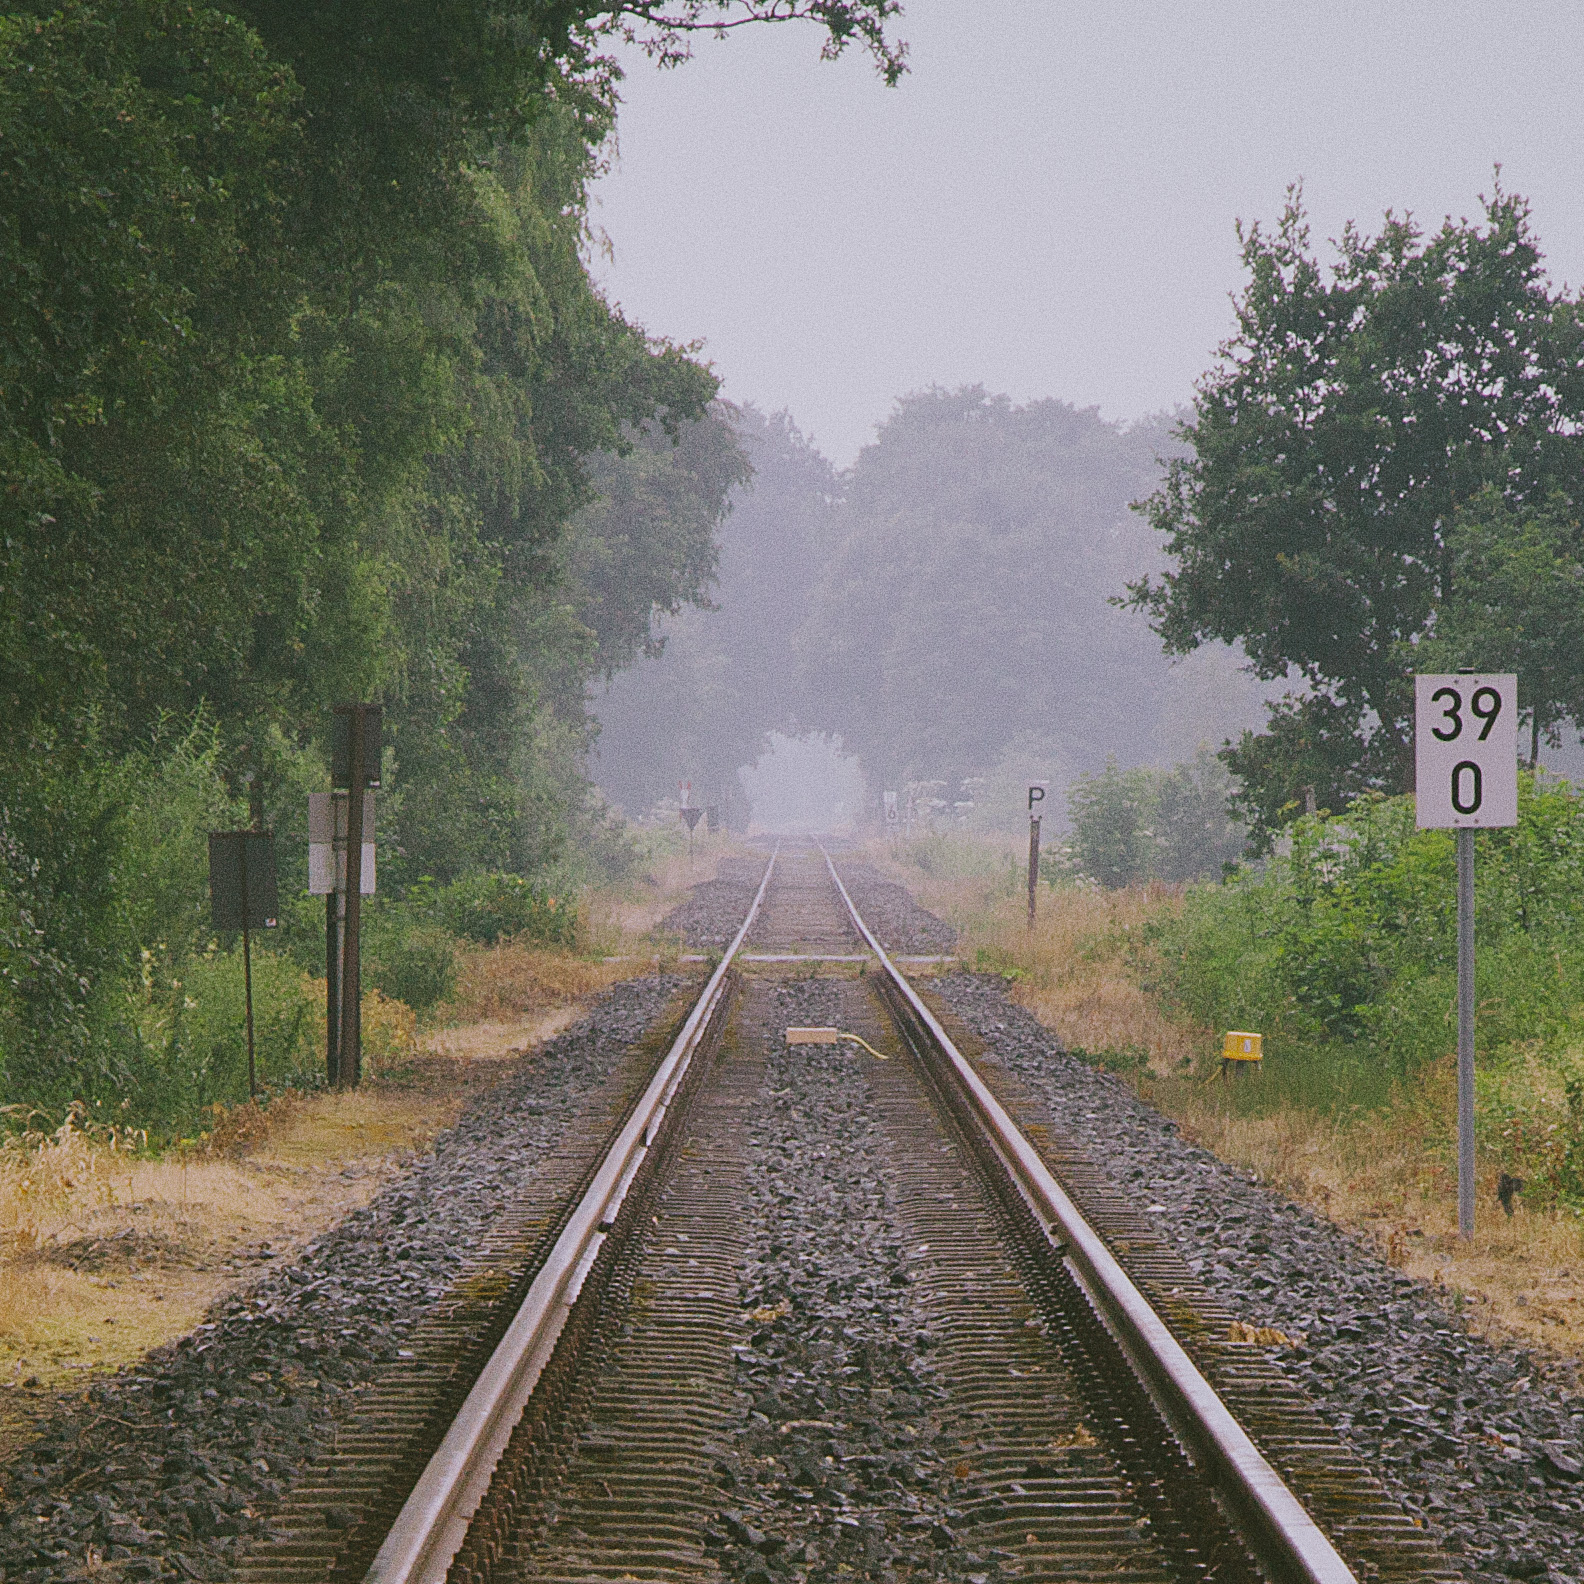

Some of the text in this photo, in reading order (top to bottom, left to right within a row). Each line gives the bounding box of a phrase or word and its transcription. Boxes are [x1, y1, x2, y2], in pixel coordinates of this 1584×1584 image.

[1431, 686, 1502, 742] 39
[1028, 786, 1046, 811] P
[1451, 760, 1482, 815] 0
